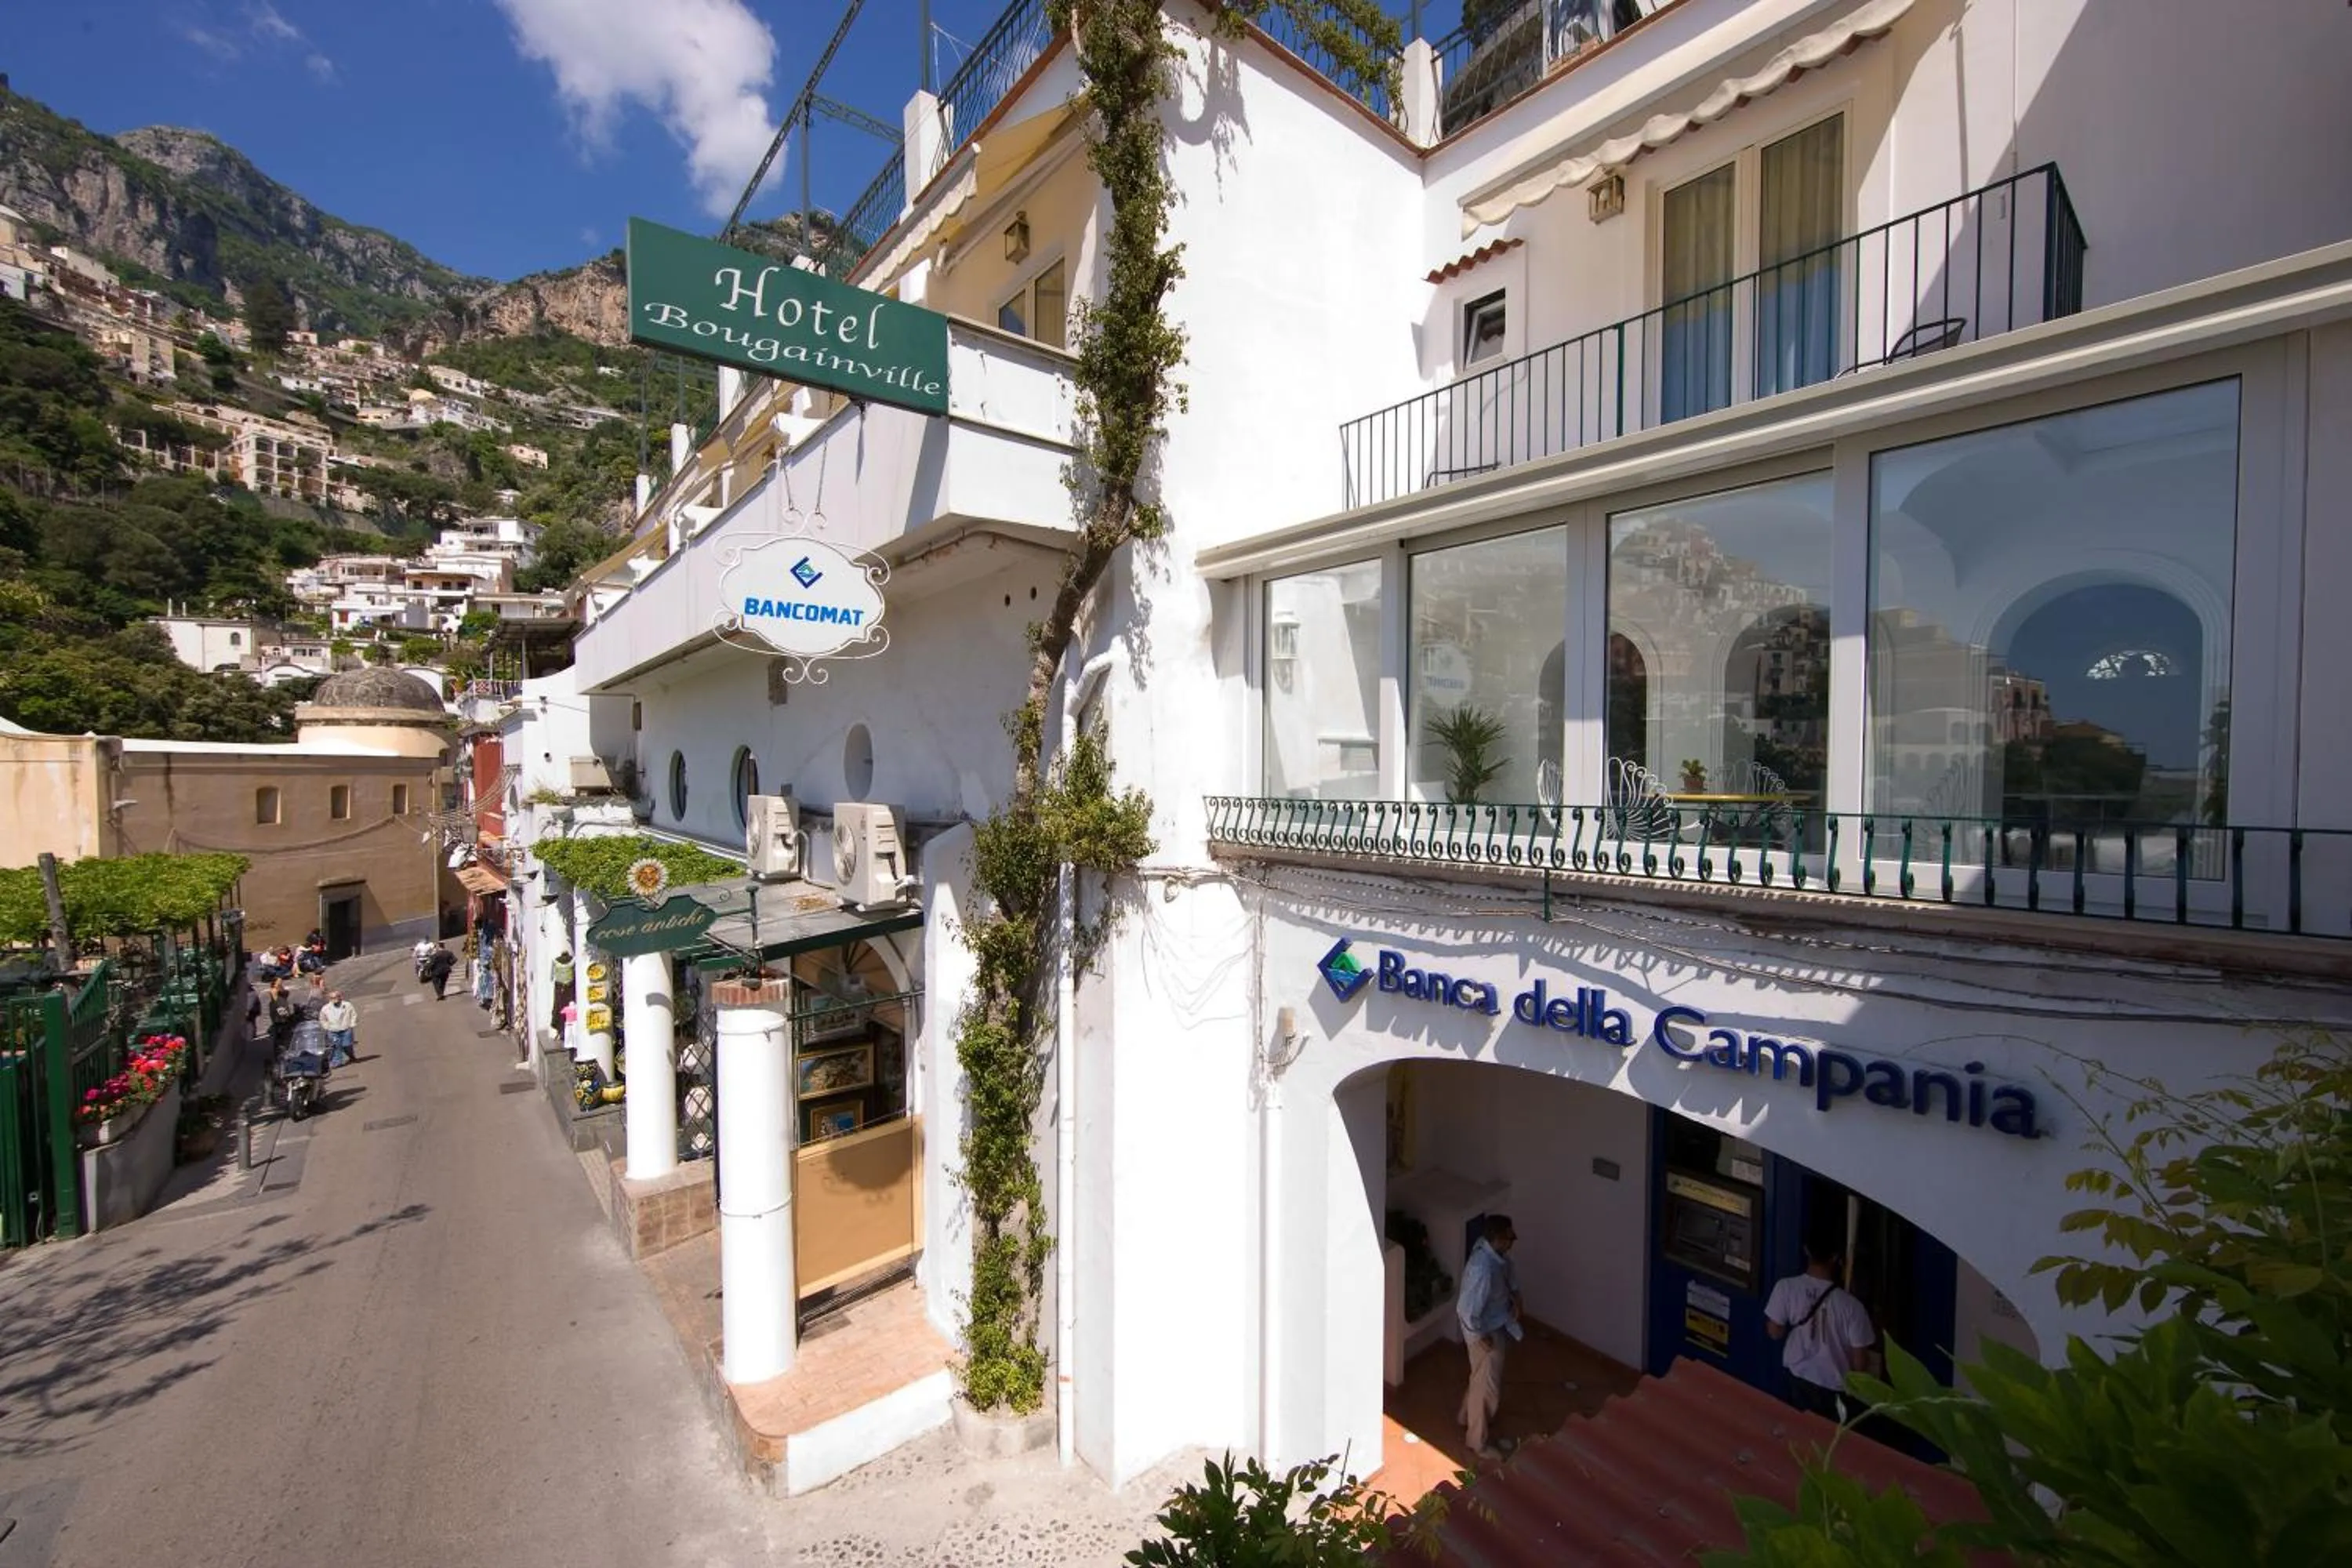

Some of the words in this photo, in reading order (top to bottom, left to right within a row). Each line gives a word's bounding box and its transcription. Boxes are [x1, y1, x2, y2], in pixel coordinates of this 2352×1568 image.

[644, 302, 941, 395] Bougainville
[714, 267, 884, 350] Hotel
[744, 597, 864, 626] BANCOMAT
[1379, 949, 1501, 1015] Banca
[1514, 978, 1636, 1047] della
[1653, 1004, 2049, 1139] Campania
